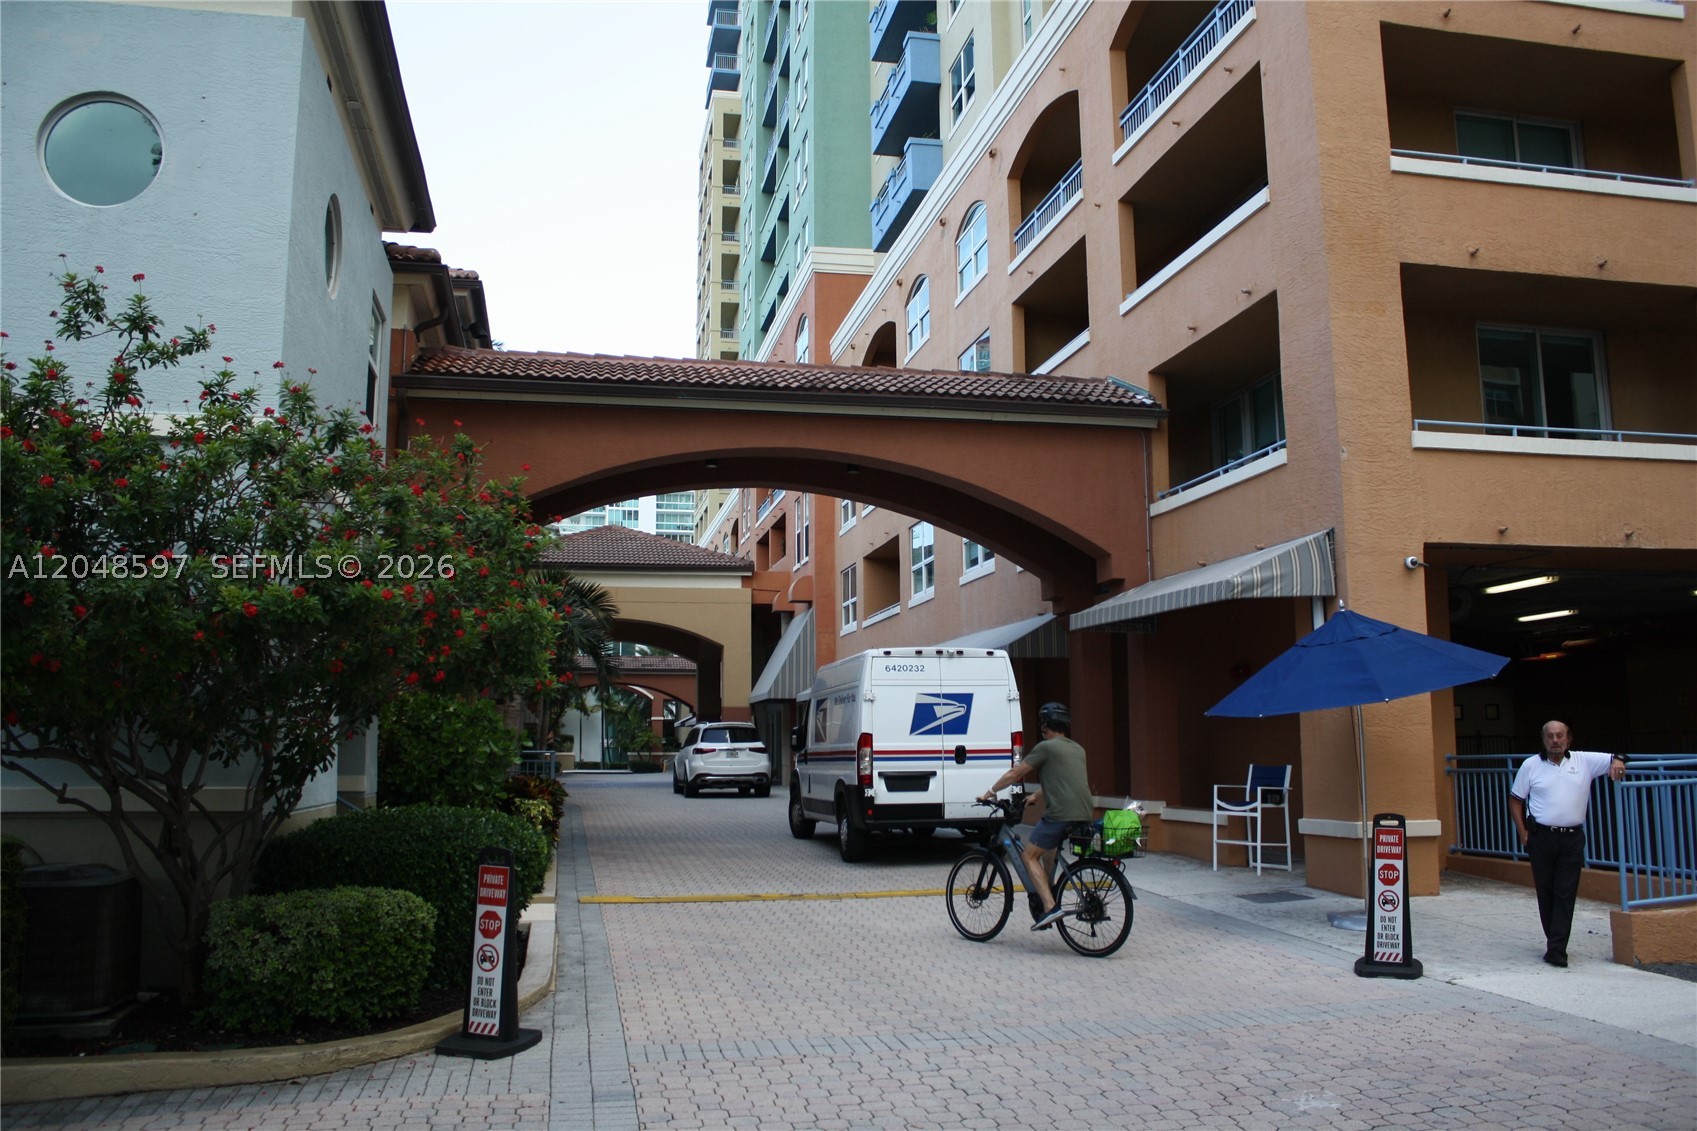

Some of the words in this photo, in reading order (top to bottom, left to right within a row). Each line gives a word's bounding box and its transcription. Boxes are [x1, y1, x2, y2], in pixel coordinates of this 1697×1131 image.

[884, 664, 925, 673] 6420232
[1379, 834, 1399, 843] PRIVATE
[1376, 845, 1402, 854] DRIVEWAY
[483, 873, 504, 885] PRIVATE
[1379, 870, 1399, 879] STOP
[480, 887, 506, 899] DRIVEWAY
[1380, 915, 1387, 924] DO
[1388, 916, 1397, 924] NOT
[480, 918, 501, 931] STOP
[1381, 924, 1396, 932] ENTER
[1377, 932, 1384, 940] OR
[1385, 933, 1399, 941] BLOCK
[1377, 941, 1400, 949] DRIVEWAY
[477, 975, 483, 986] DO
[485, 977, 495, 987] NOT
[477, 987, 493, 997] ENTER
[473, 997, 480, 1007] OR
[481, 998, 496, 1009] BLOCK
[472, 1008, 497, 1019] DRIVEWAY
